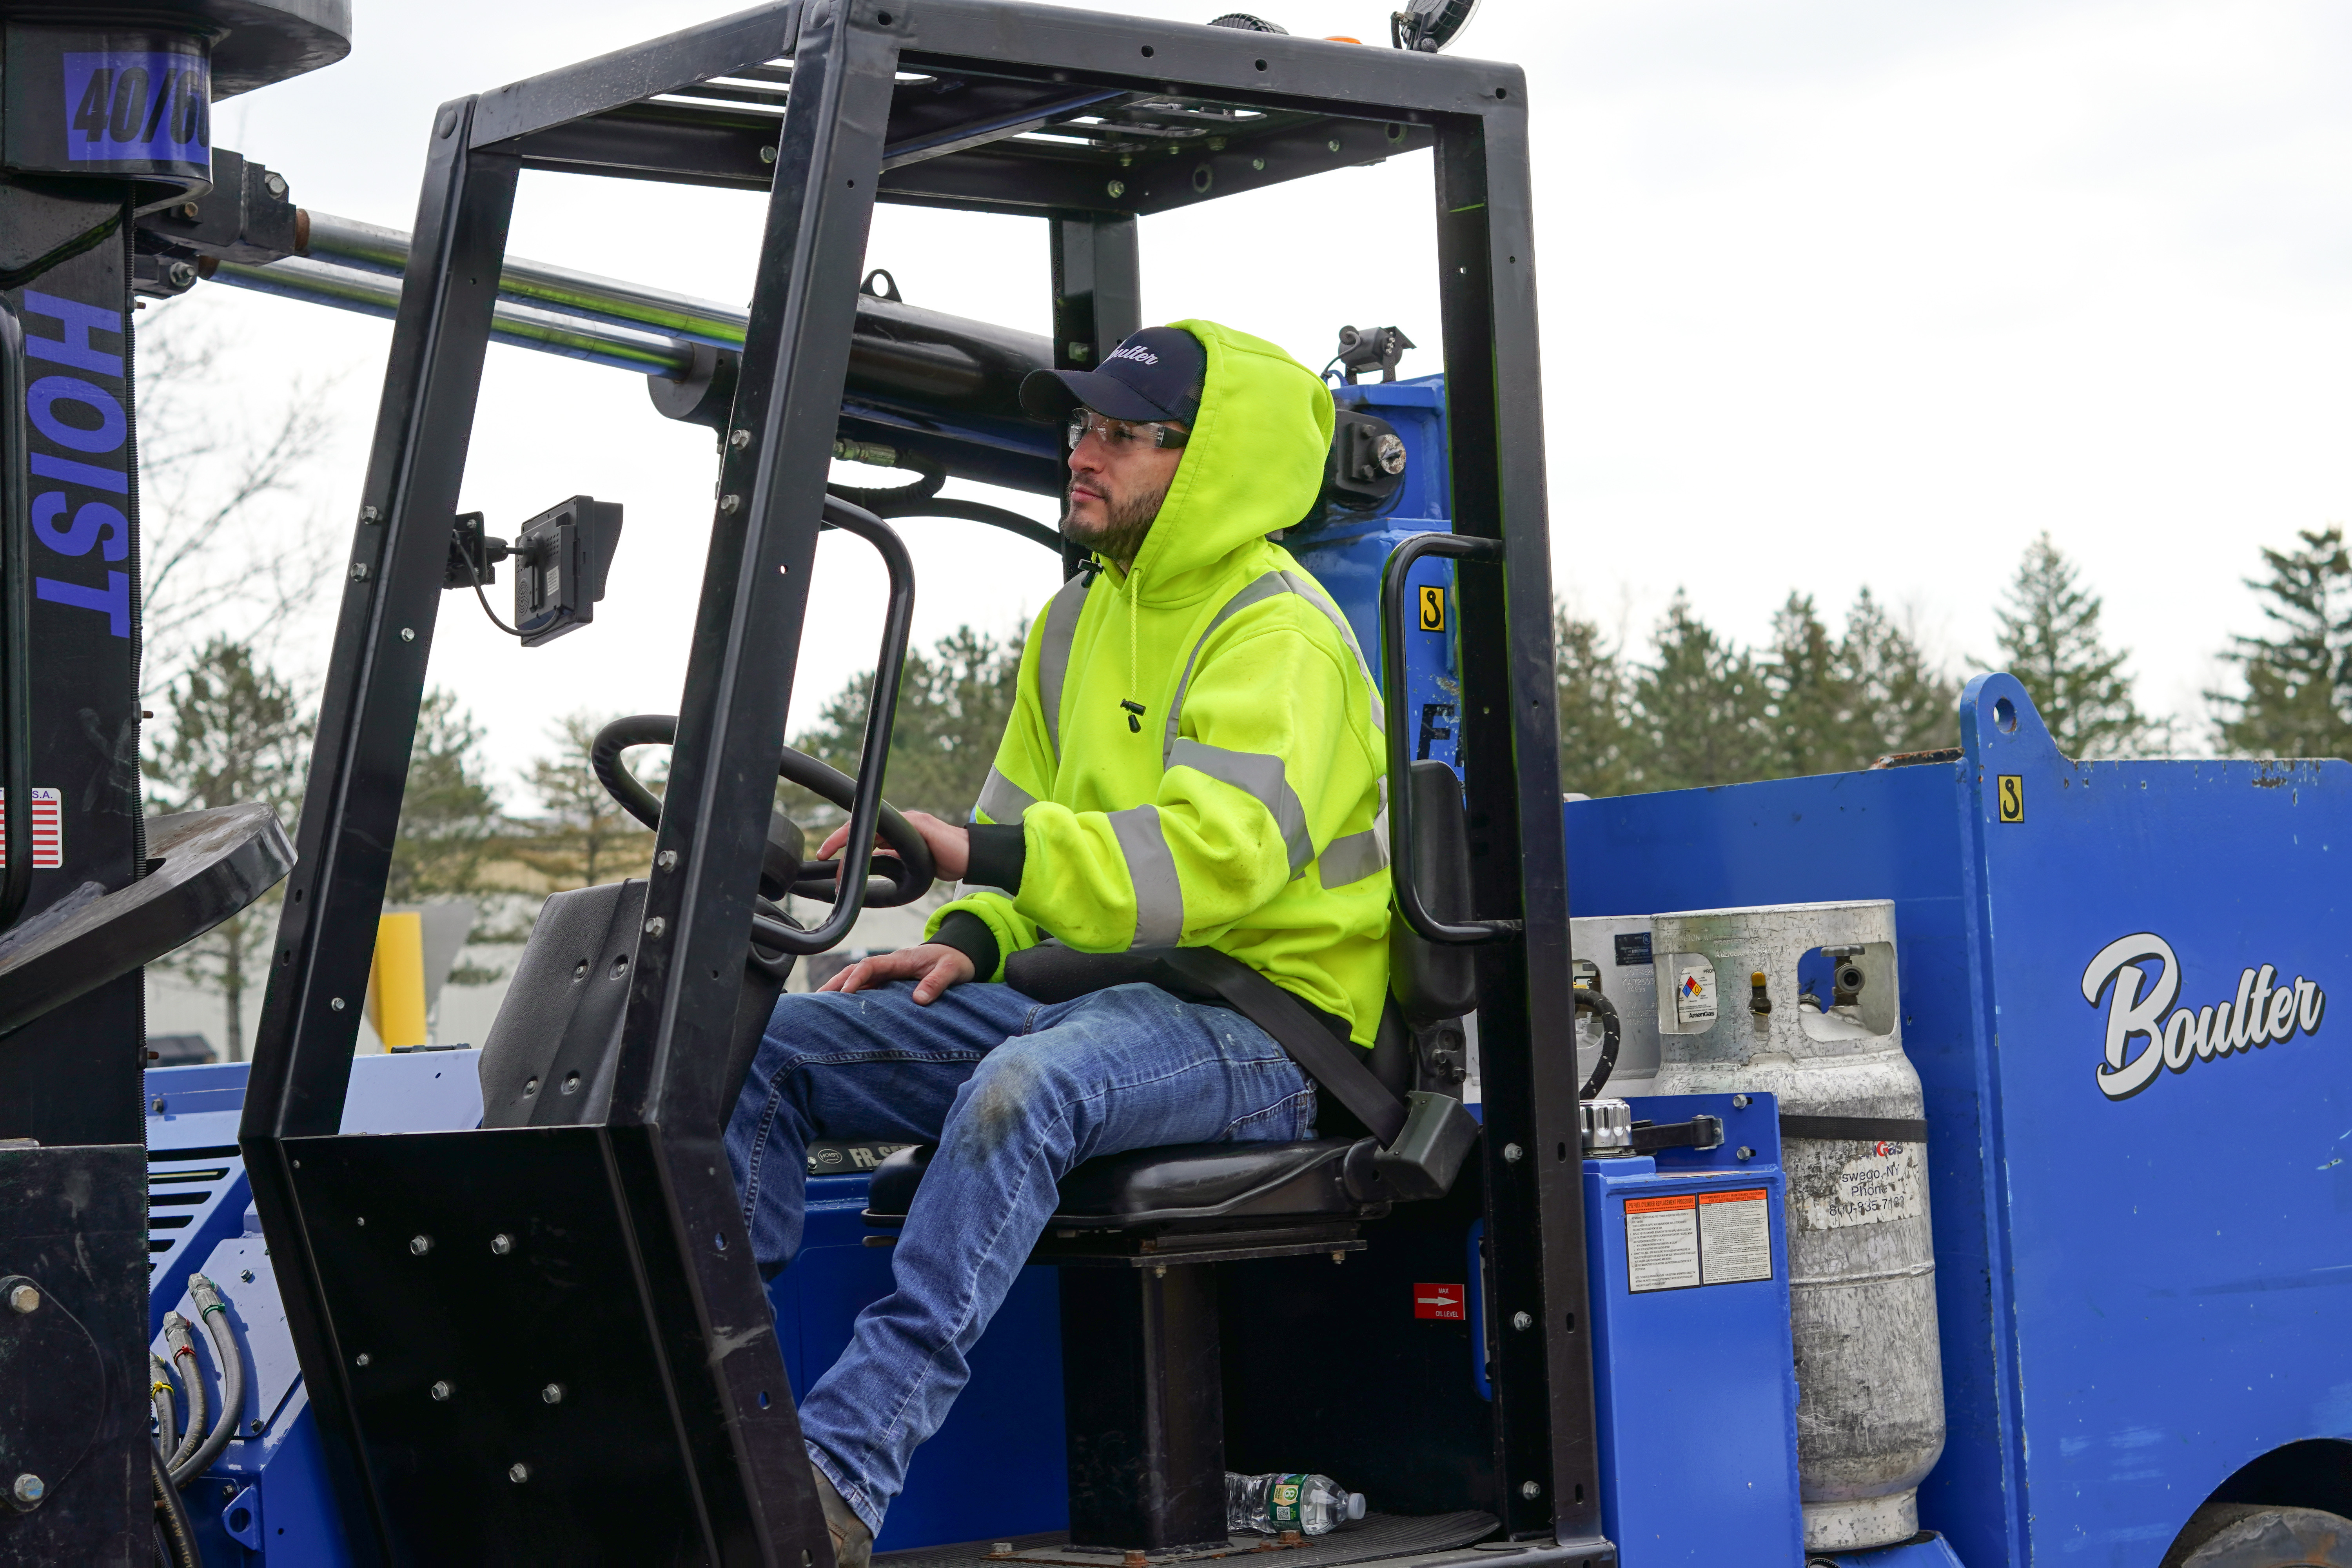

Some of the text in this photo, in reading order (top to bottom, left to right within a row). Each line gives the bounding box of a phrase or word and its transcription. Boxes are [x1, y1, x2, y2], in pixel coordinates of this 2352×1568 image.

[24, 289, 130, 638] HOIST
[2082, 932, 2325, 1102] Boulter
[1851, 1185, 1887, 1196] Phone
[1886, 1164, 1899, 1177] NY
